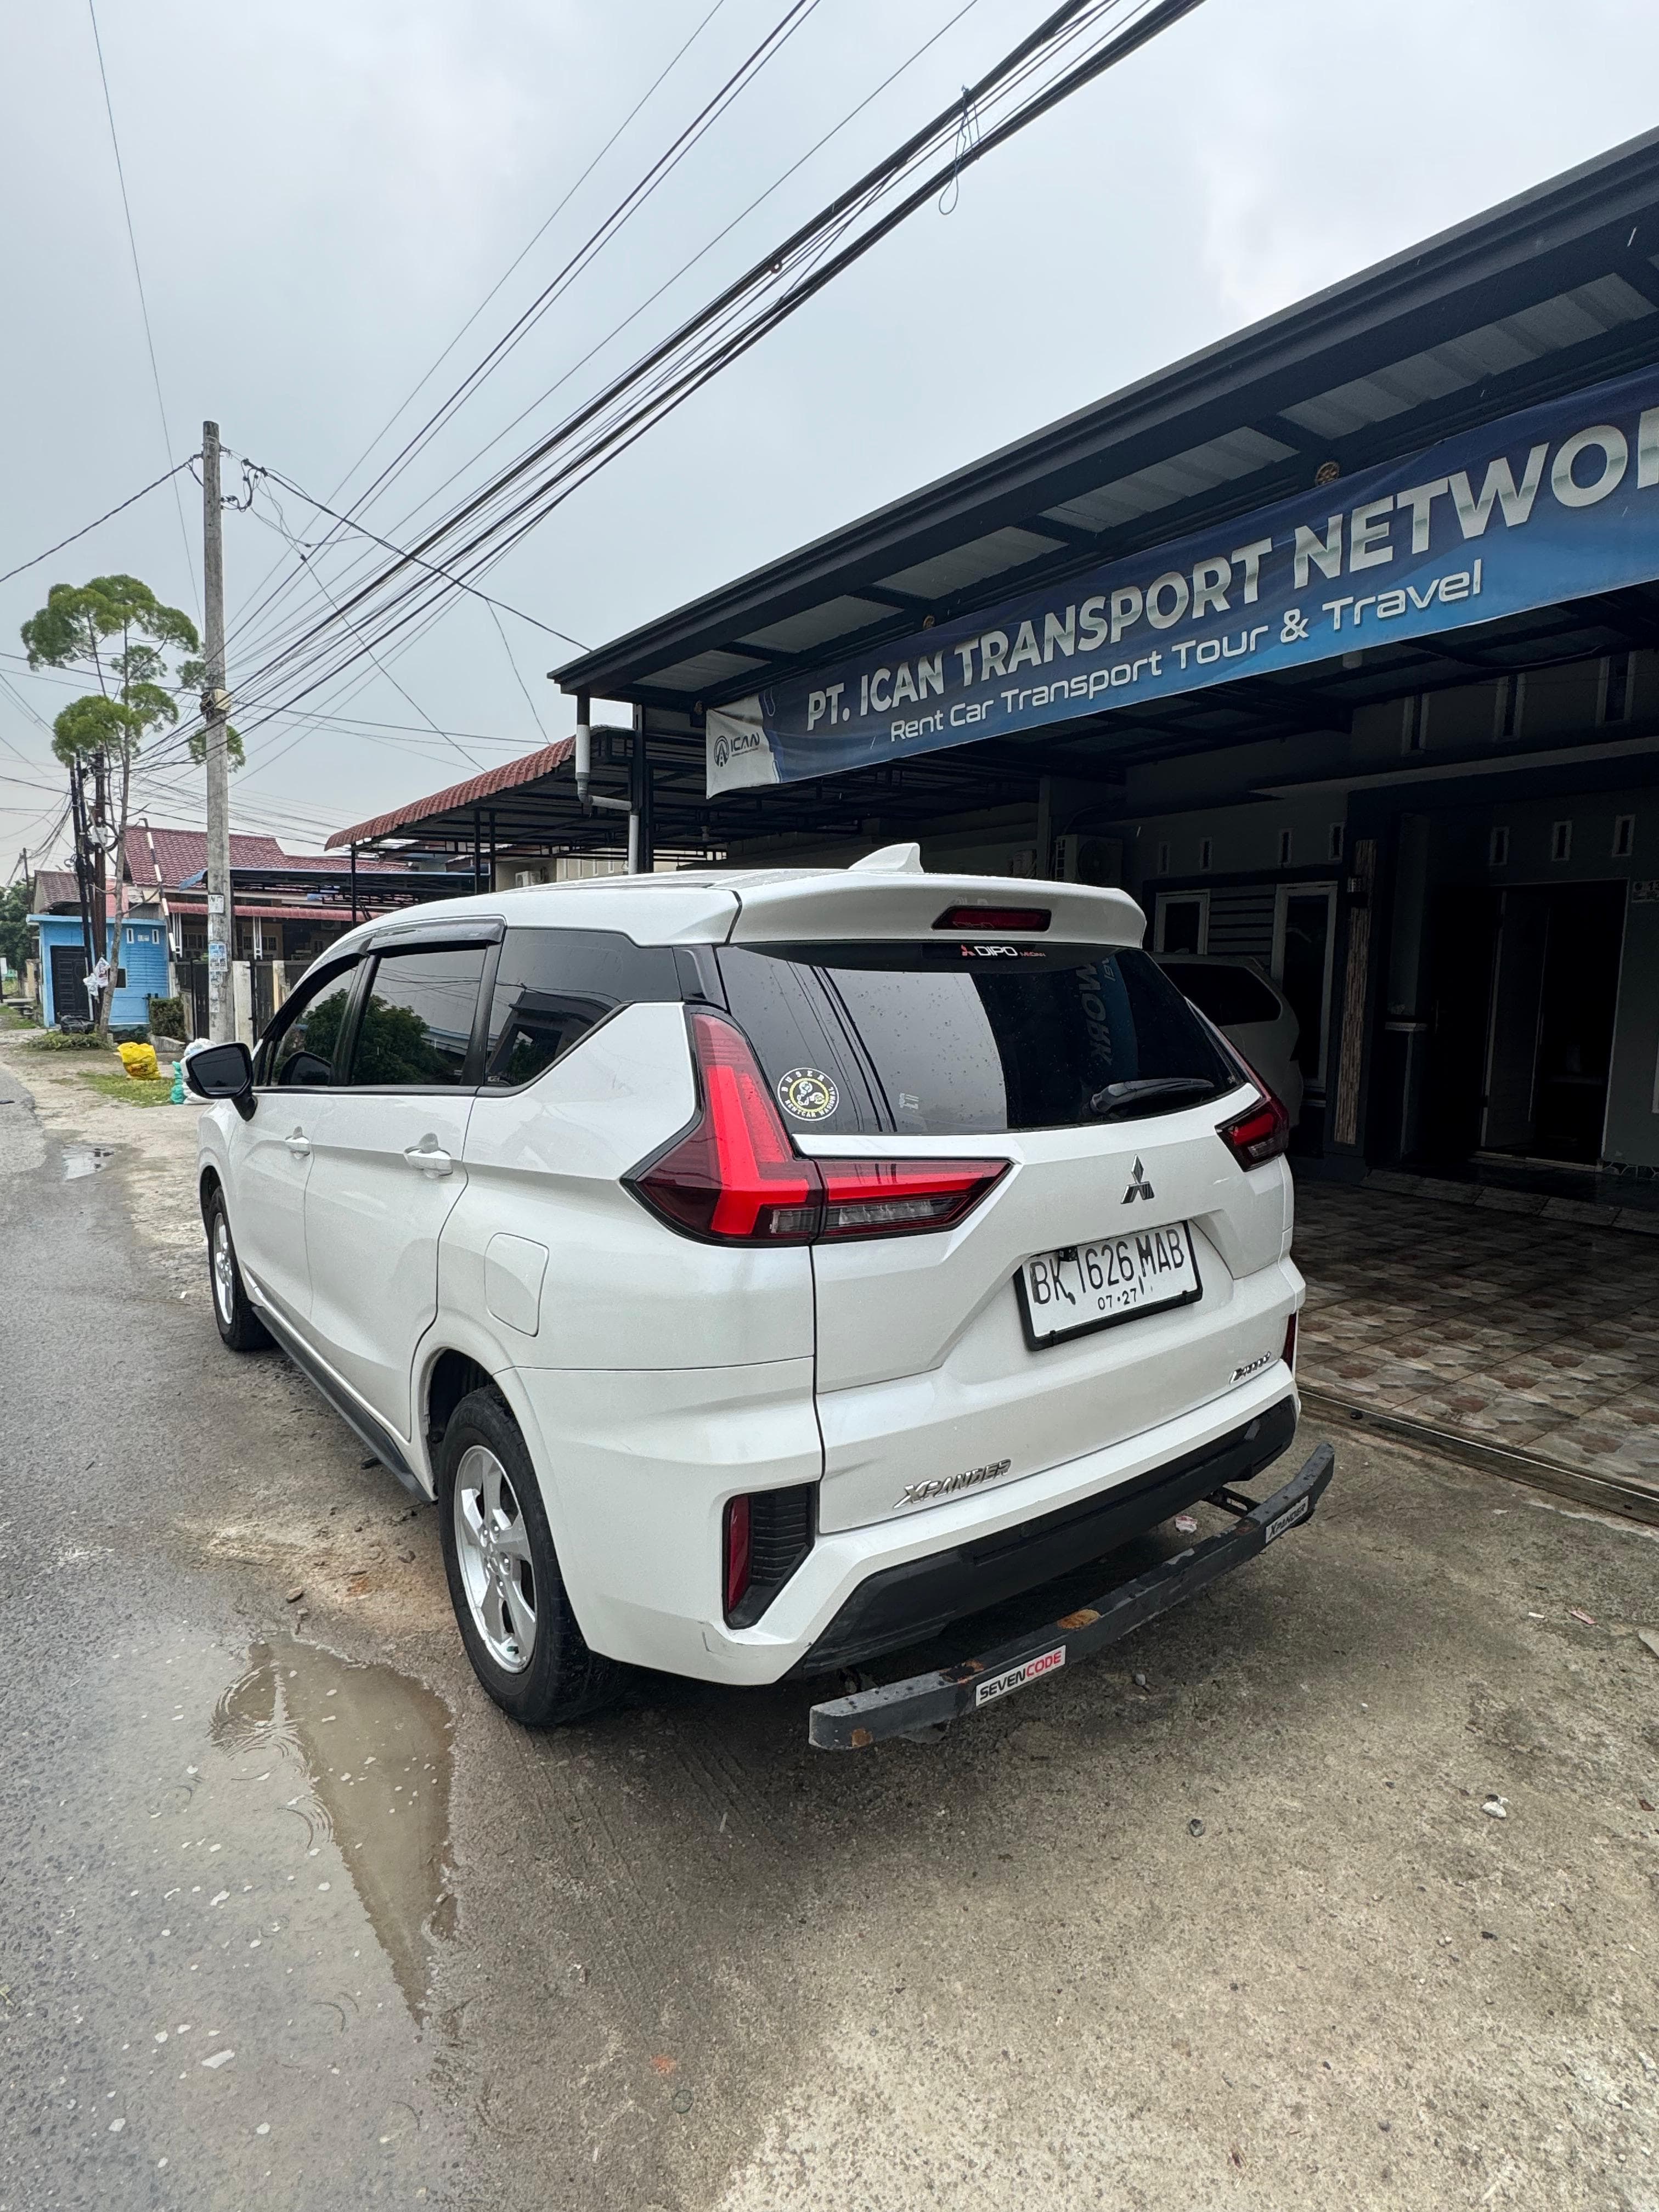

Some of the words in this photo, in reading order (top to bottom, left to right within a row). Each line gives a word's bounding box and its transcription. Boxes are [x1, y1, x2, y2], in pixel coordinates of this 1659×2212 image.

[807, 682, 850, 731] PT.
[860, 650, 944, 717] ICAN
[953, 537, 1272, 687] TRANSPORT
[890, 709, 944, 742] Rent
[950, 699, 994, 726] Car
[1000, 651, 1162, 713] Transport
[1171, 625, 1269, 670] Tour
[1280, 608, 1310, 644] &
[1322, 559, 1482, 631] Travel
[731, 732, 760, 752] ICAN
[974, 946, 1018, 956] DIPO
[1030, 1259, 1069, 1305] BK
[1077, 1241, 1134, 1294] 1626
[1135, 1229, 1184, 1277] MAB
[893, 1459, 1012, 1509] XPANDER
